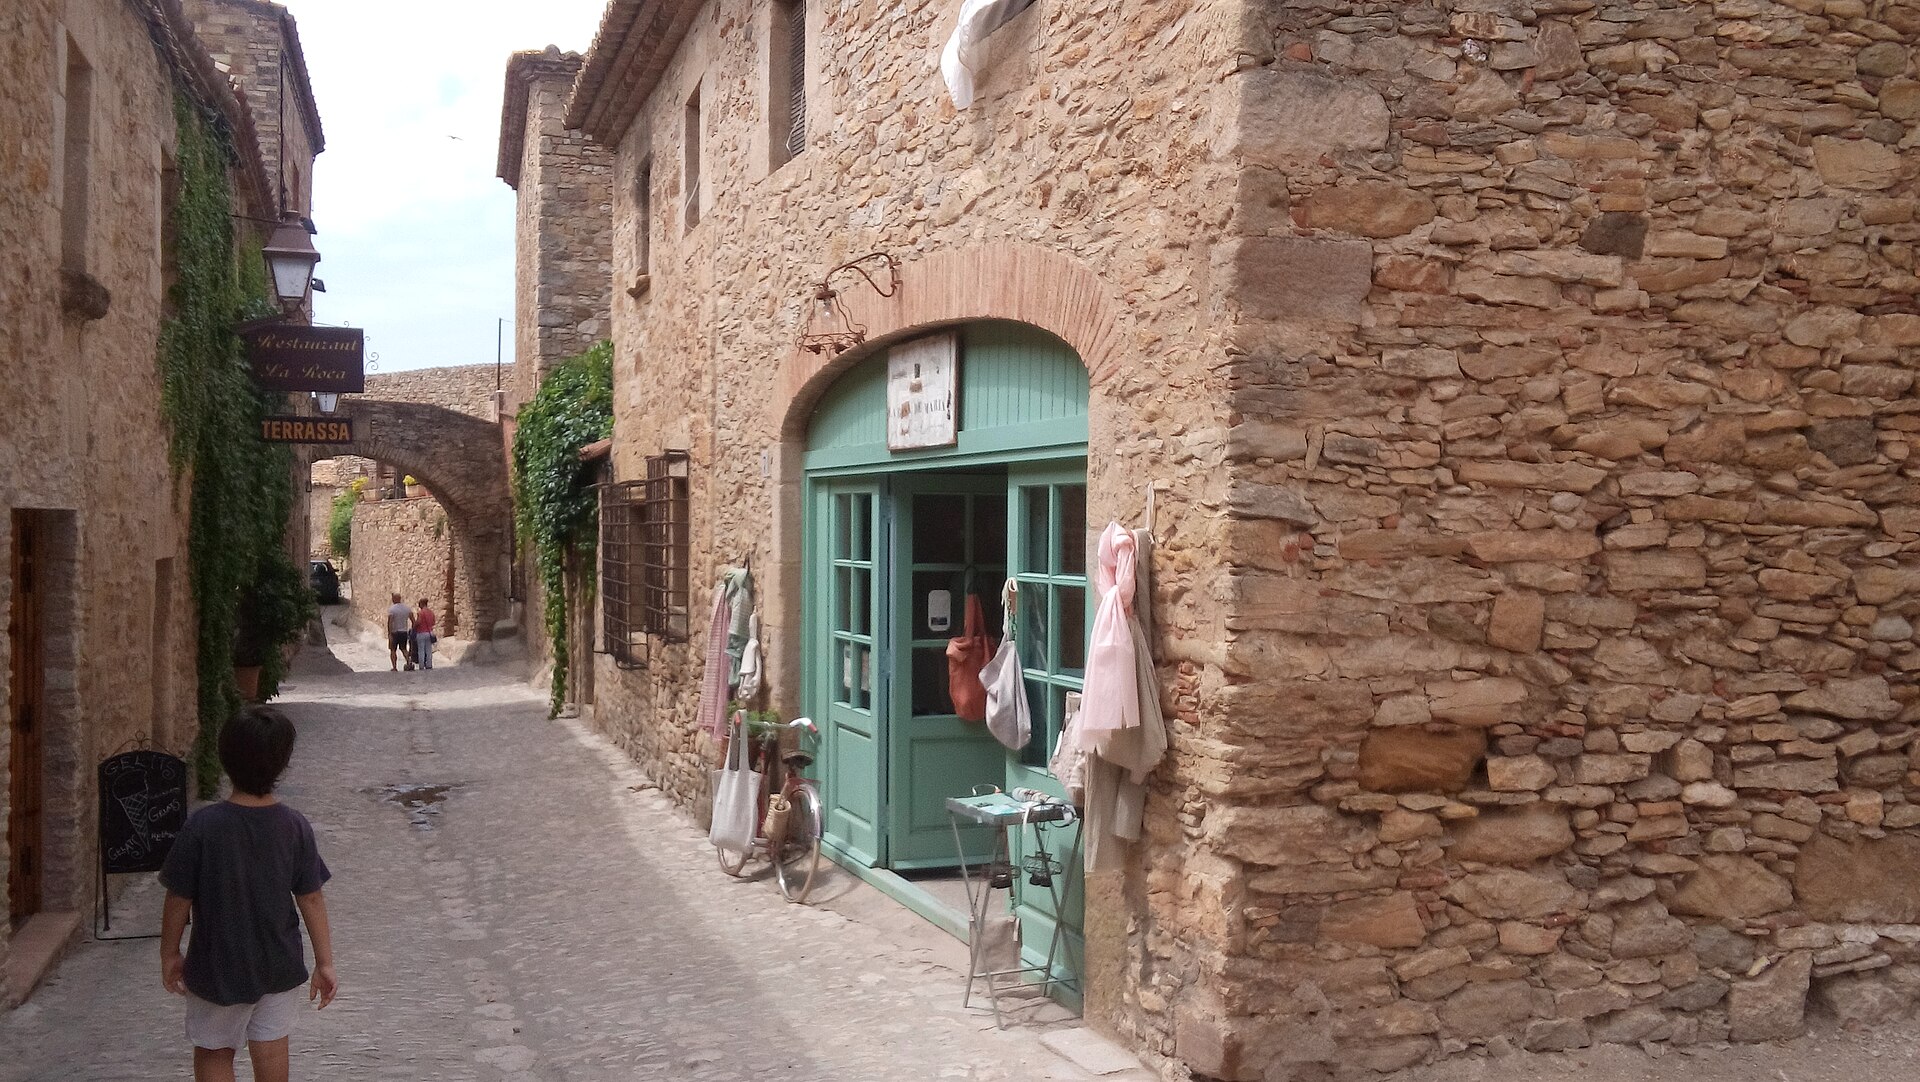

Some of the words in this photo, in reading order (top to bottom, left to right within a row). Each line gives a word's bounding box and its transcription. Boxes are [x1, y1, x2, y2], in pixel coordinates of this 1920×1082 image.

[257, 333, 358, 351] Restaurant
[261, 362, 290, 378] La
[301, 362, 346, 379] Roca
[261, 420, 350, 440] TERRASSA
